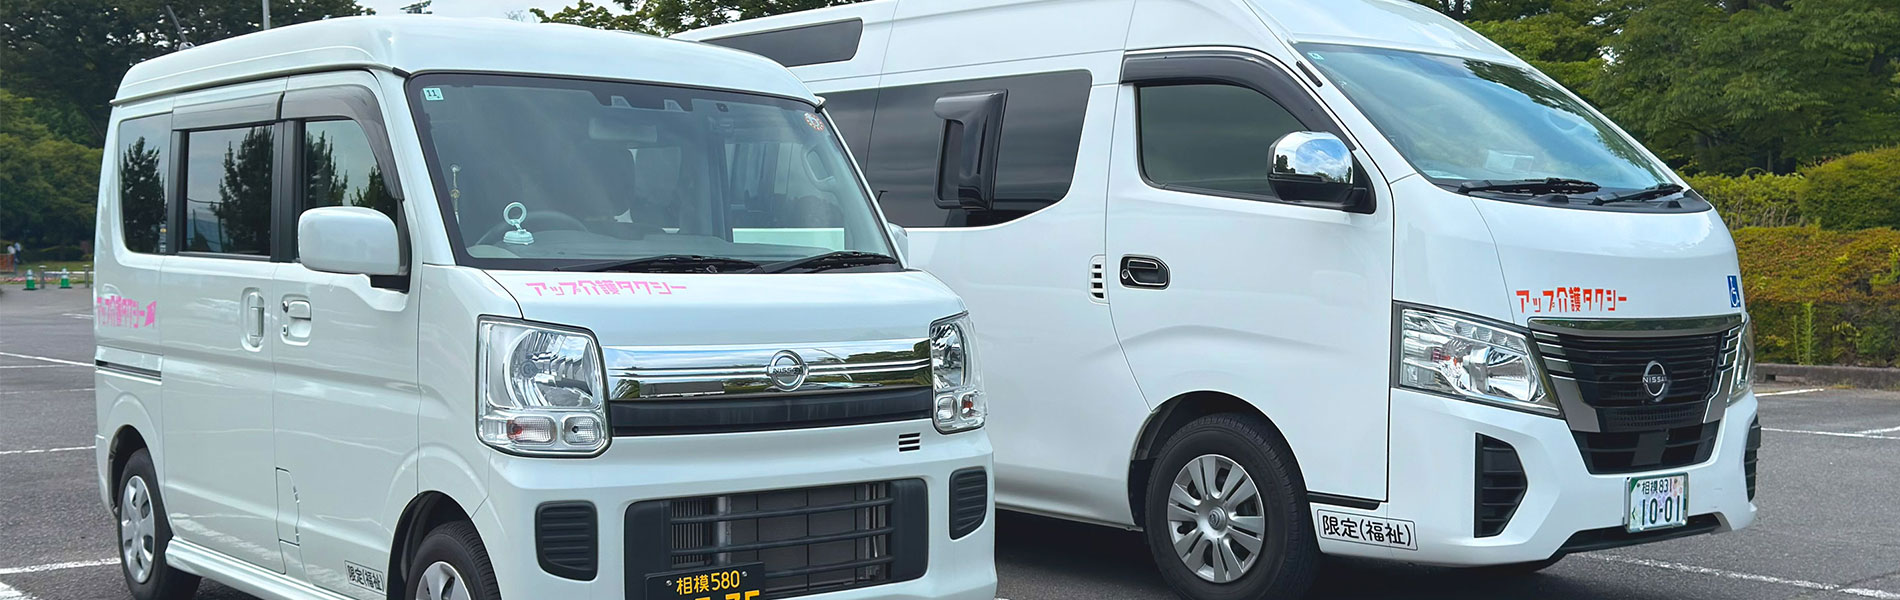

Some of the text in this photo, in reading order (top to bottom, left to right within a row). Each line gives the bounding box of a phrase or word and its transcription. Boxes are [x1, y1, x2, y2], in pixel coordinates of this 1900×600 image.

[526, 280, 687, 296] アップ介護タクシー
[1516, 287, 1627, 313] アップ介護タクシー
[1642, 495, 1680, 525] 10-01
[1322, 515, 1411, 546] 限定(福祉)
[347, 565, 384, 592] 限定(福祉)
[676, 570, 740, 595] 相模580
